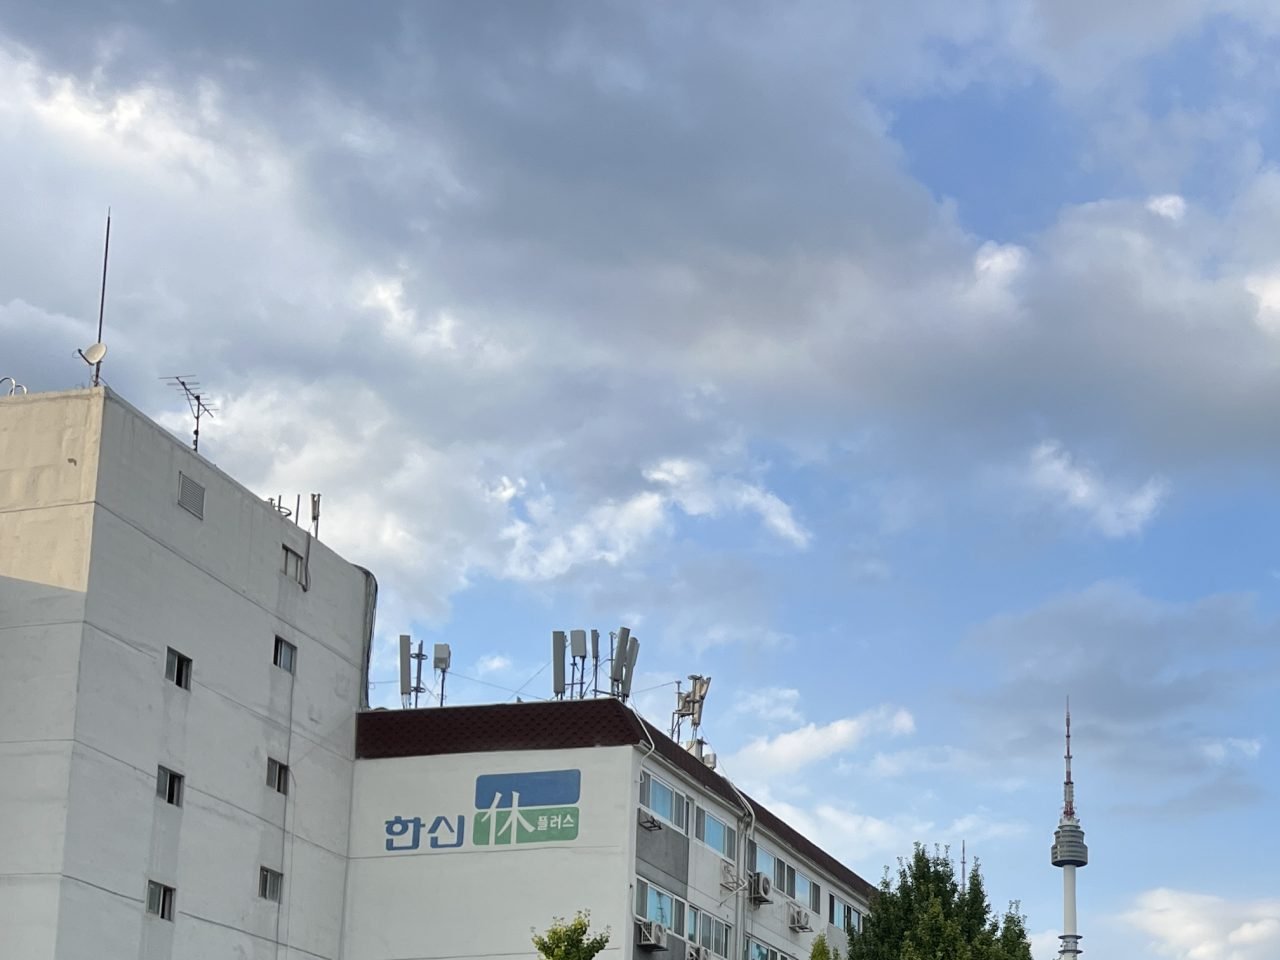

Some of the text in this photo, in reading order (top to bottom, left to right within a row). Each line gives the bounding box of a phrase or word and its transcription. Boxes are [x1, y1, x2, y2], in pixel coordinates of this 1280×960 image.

[385, 791, 575, 851] 한신 休 플러스
